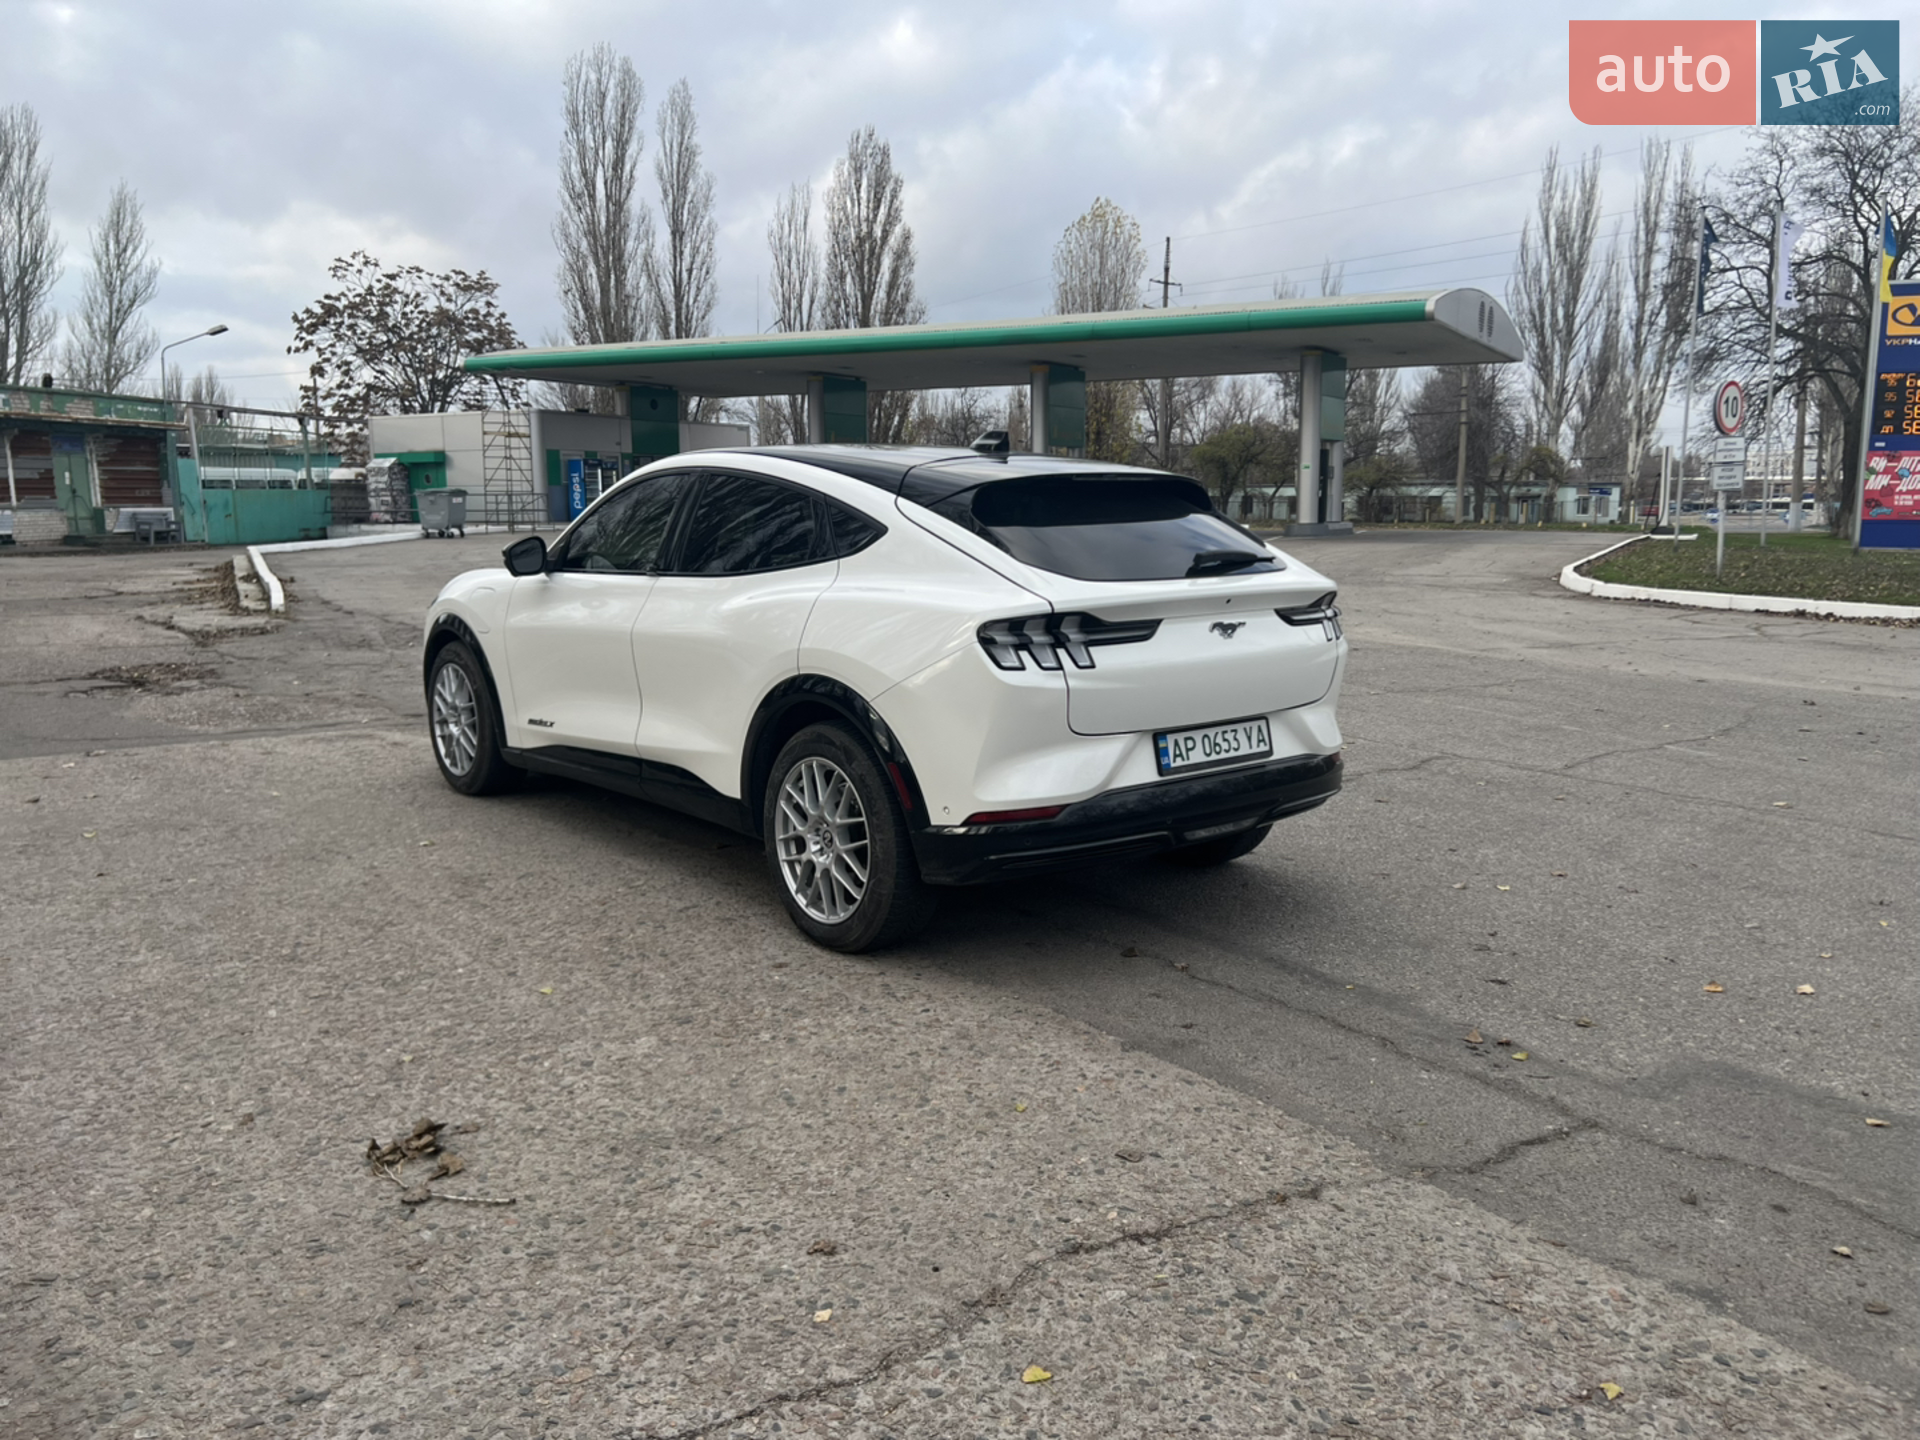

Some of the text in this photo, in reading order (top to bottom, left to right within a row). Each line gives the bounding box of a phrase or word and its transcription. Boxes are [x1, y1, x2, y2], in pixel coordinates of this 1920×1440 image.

[1723, 396, 1739, 418] 10
[1884, 392, 1897, 402] 95
[571, 472, 583, 509] pepsi
[1172, 724, 1268, 763] AP 0653 YA
